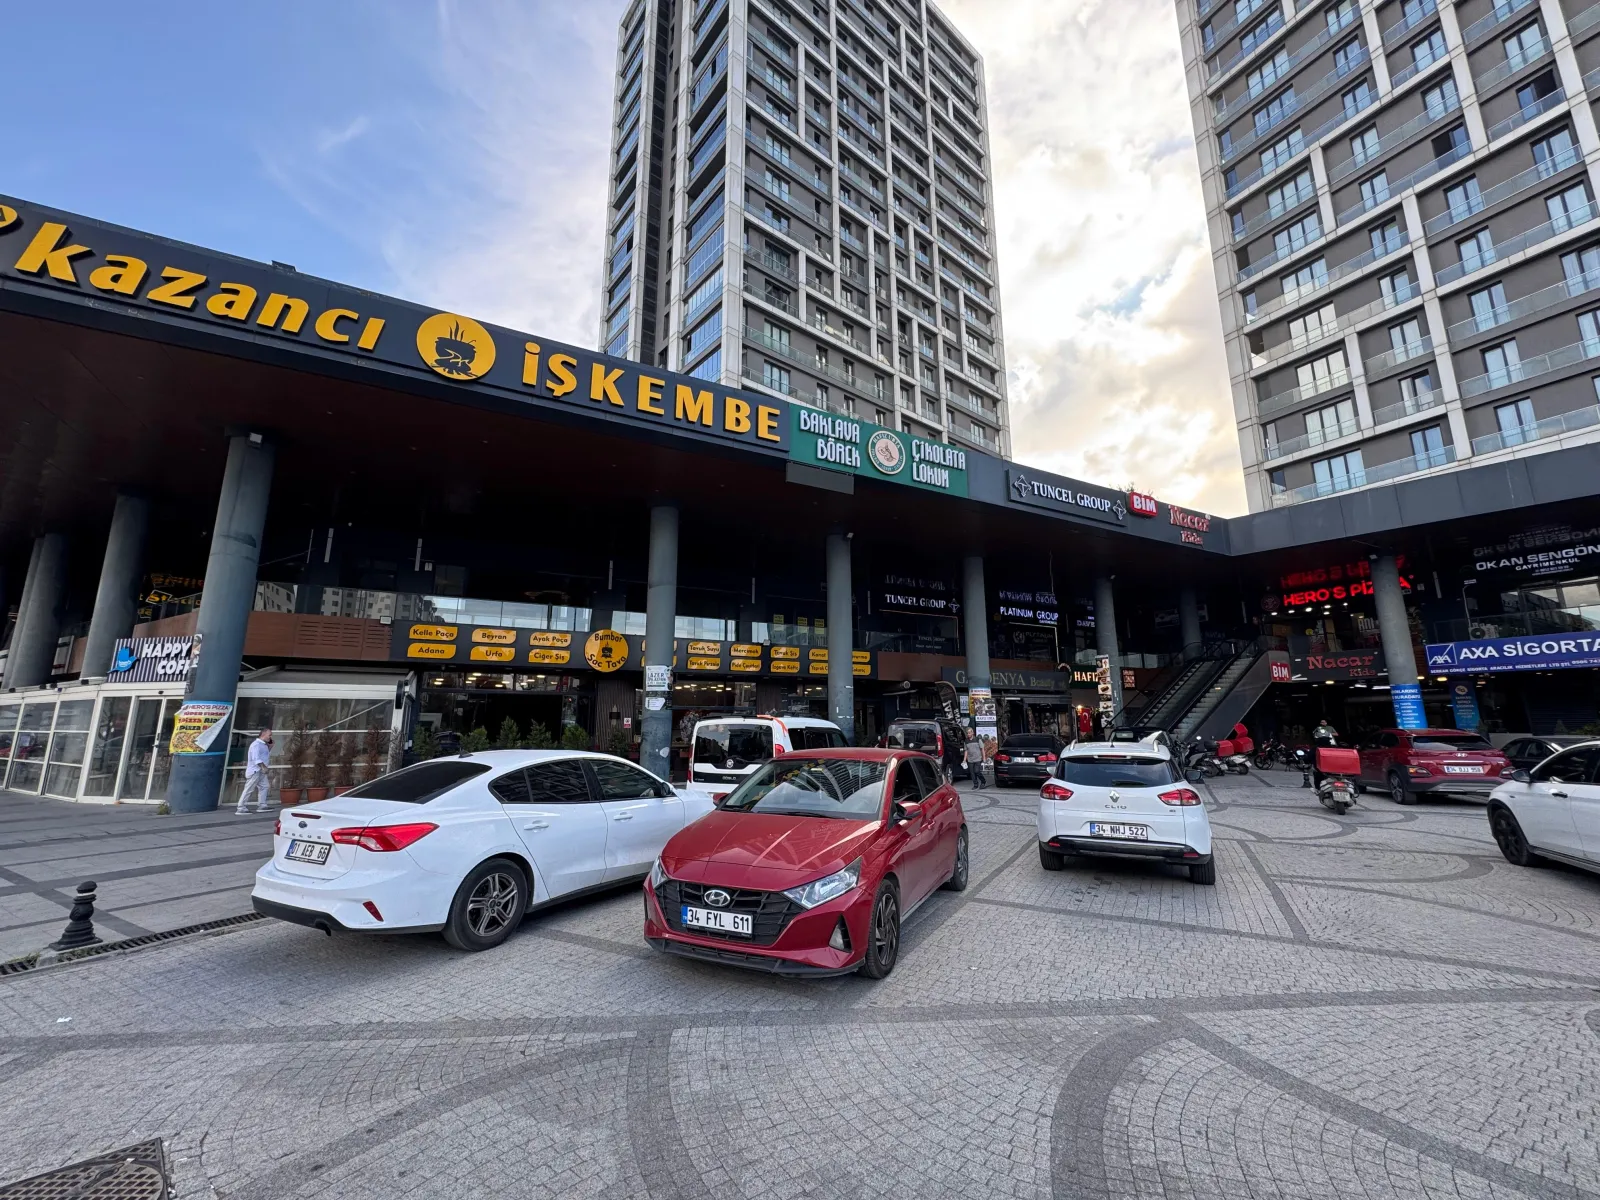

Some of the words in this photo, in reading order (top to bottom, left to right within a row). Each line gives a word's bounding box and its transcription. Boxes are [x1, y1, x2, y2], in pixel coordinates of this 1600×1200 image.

[14, 222, 387, 351] kazancı
[522, 341, 782, 442] İŞKEMBE
[800, 409, 860, 444] BAKLAVA
[817, 438, 861, 468] BÖREK
[911, 439, 966, 470] ÇİKOLATA
[912, 462, 949, 488] LOKUM
[1031, 481, 1075, 504] TUNCEL
[1077, 493, 1111, 512] GROUP
[1476, 556, 1524, 571] OKAN
[1284, 586, 1347, 606] HERO'S
[1351, 576, 1411, 597] PİZA
[885, 594, 918, 606] TUNCEL
[920, 598, 946, 609] GROUP
[1000, 607, 1034, 618] PLATINUM
[1036, 610, 1059, 620] GROUP
[413, 629, 433, 637] Kelle
[436, 630, 454, 638] Paça
[482, 633, 507, 641] Beyran
[594, 633, 623, 643] Bumbar
[142, 643, 192, 658] HAPPY
[418, 647, 445, 655] Adana
[1460, 646, 1499, 660] AXA
[587, 653, 603, 668] Sac
[606, 655, 627, 669] Tava
[1306, 655, 1375, 670] Nacar
[1430, 655, 1452, 664] AXA
[1349, 668, 1376, 677] Kids
[1095, 824, 1106, 834] 34
[1110, 825, 1126, 835] NHJ
[1128, 826, 1146, 837] 522
[688, 908, 700, 924] 34
[706, 911, 725, 928] FYL
[733, 915, 750, 932] 611
